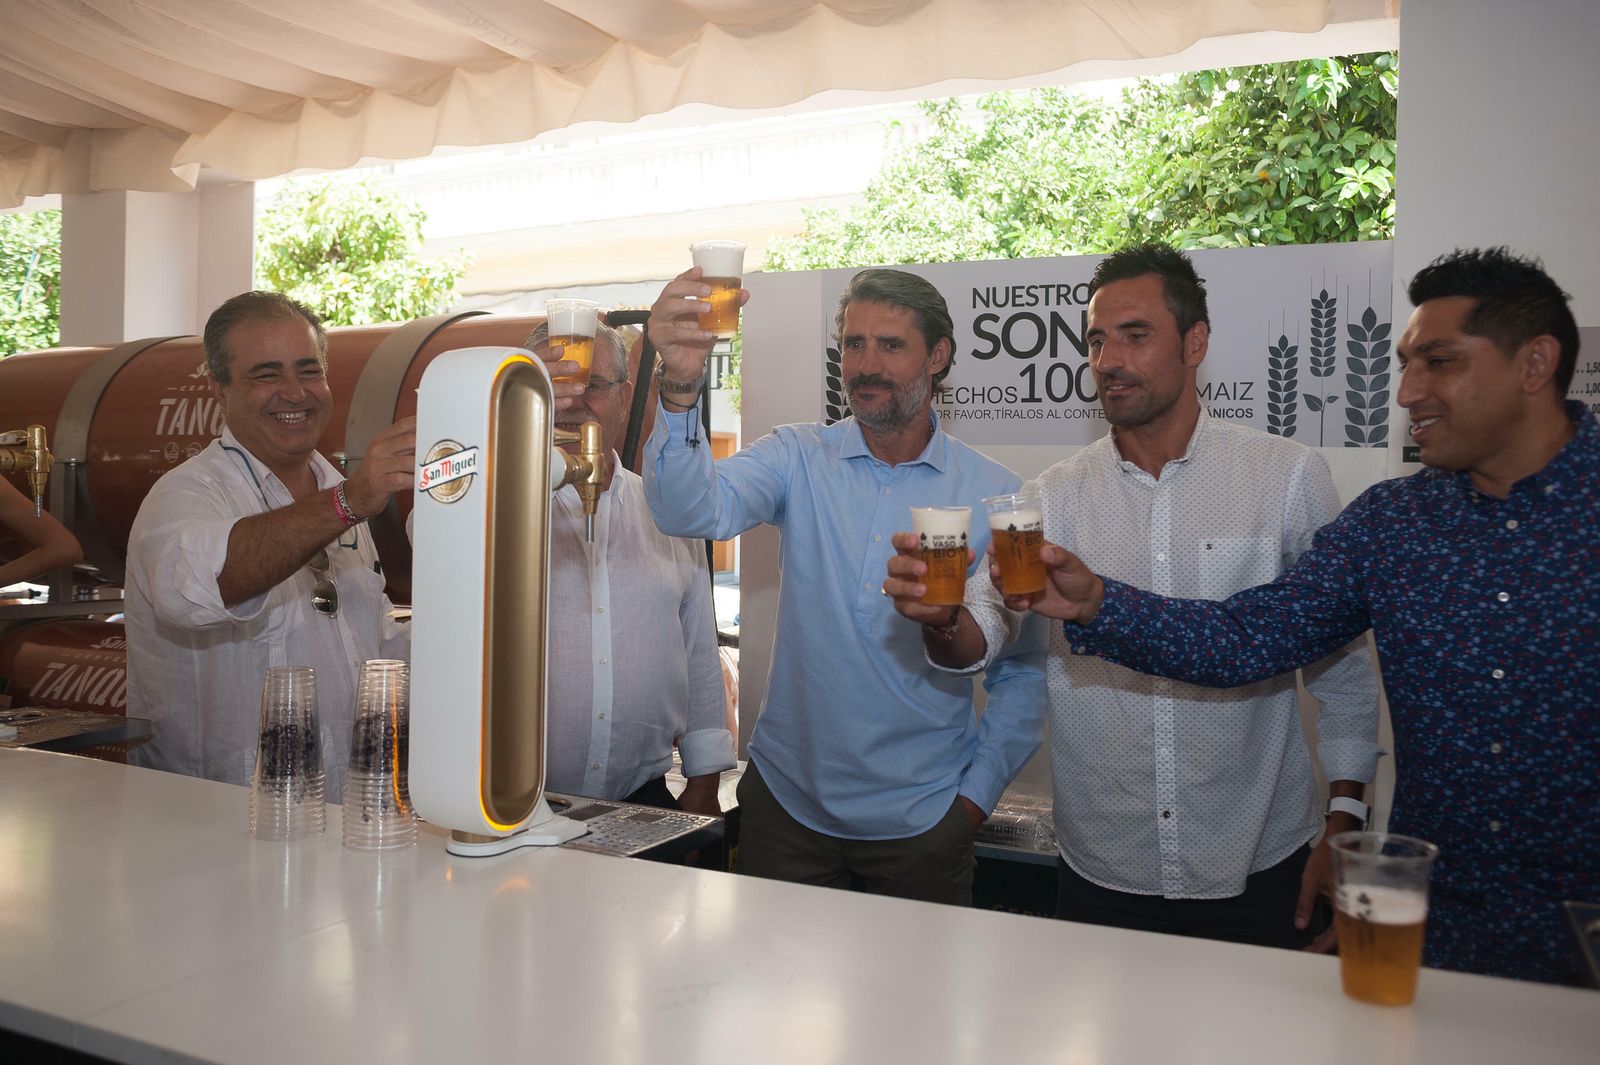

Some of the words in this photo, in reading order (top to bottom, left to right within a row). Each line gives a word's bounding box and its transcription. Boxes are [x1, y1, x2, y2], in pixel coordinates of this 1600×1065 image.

[971, 311, 1089, 360] SON
[1196, 381, 1254, 401] MAIZ
[1046, 409, 1061, 419] AL
[932, 540, 956, 548] VASO
[933, 549, 956, 559] BIO
